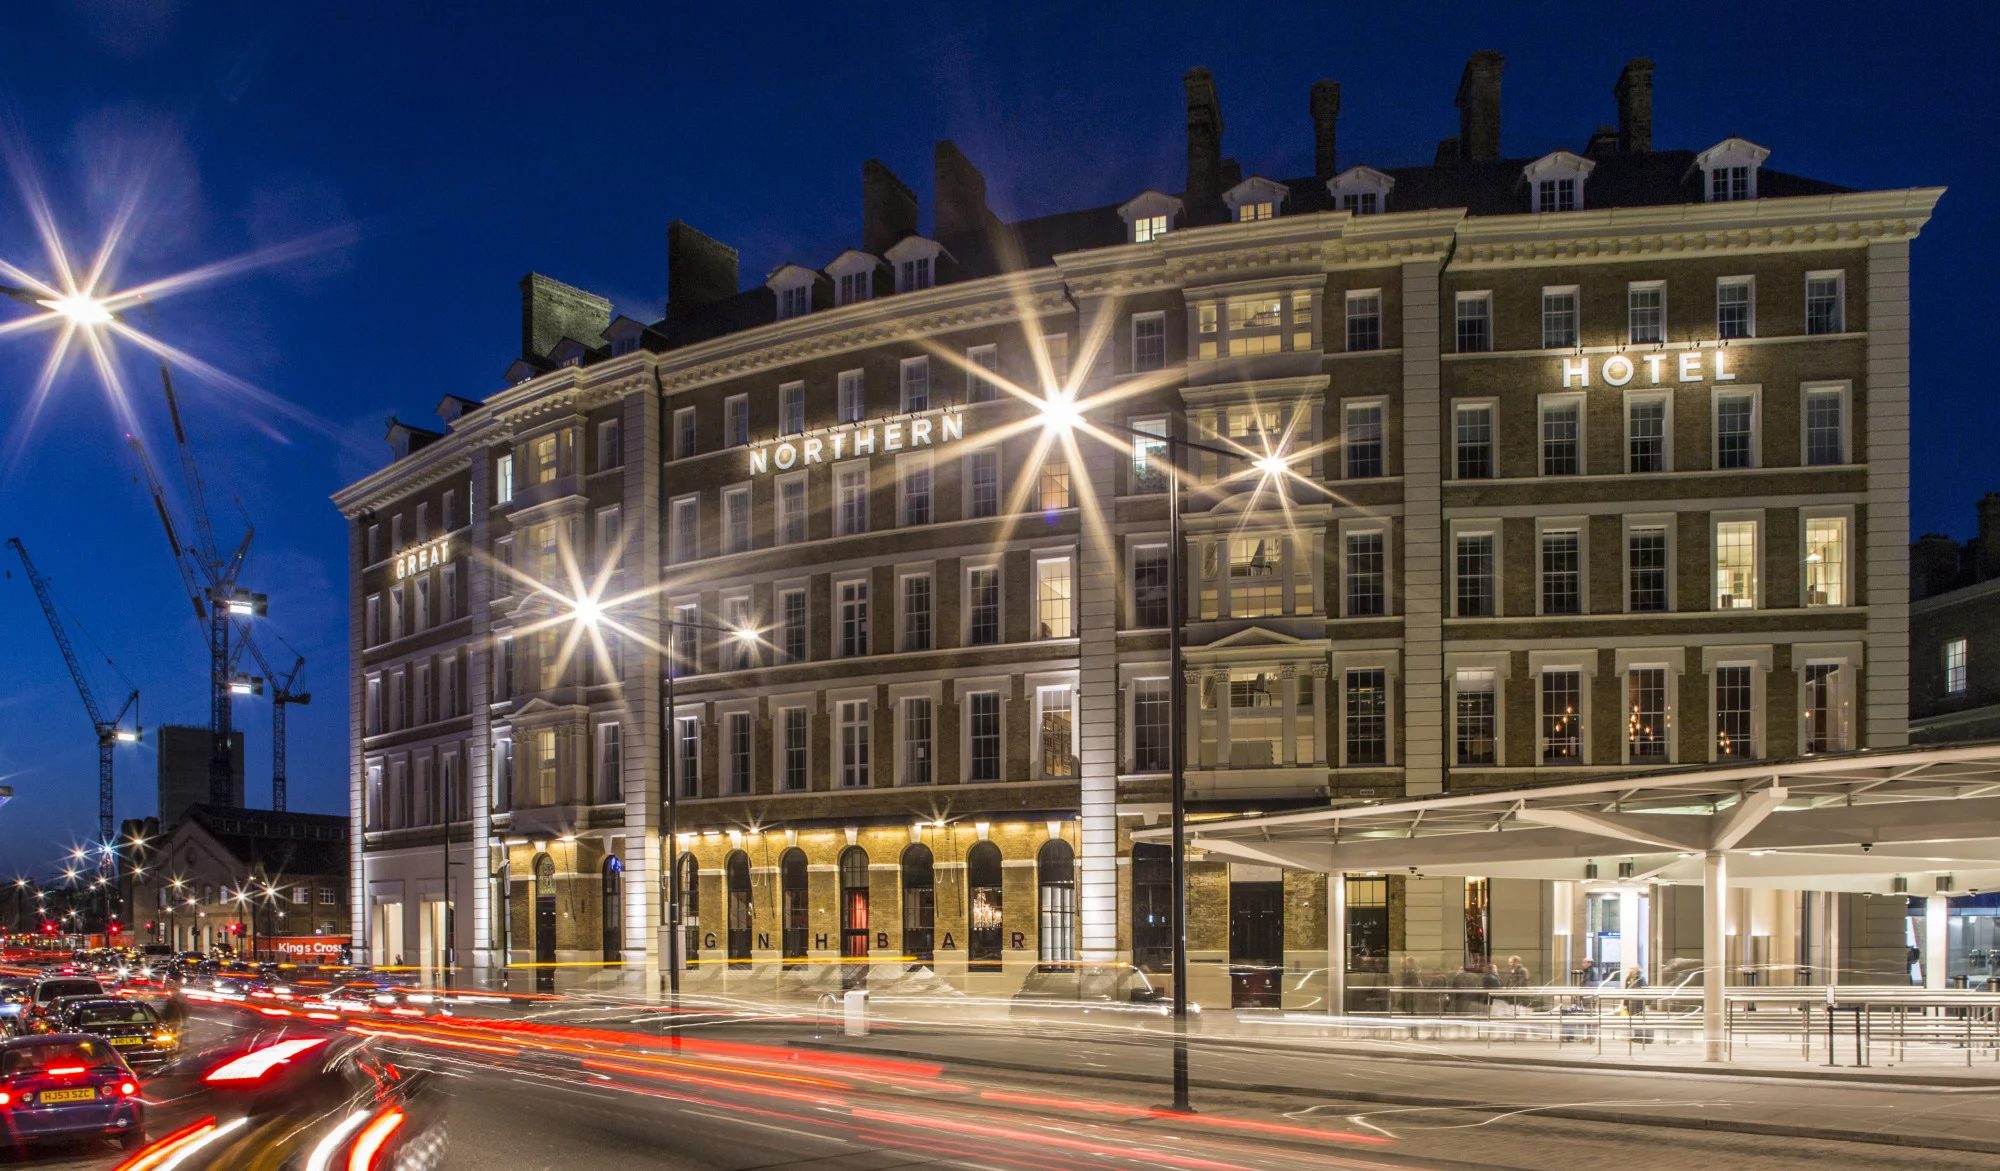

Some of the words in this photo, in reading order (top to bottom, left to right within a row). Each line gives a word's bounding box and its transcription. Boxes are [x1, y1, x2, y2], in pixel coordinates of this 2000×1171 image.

[396, 541, 449, 580] GREAT
[750, 413, 963, 476] NORTHERN
[1562, 351, 1736, 388] HOTEL
[876, 931, 1026, 949] BAR
[44, 1091, 70, 1101] HJ53
[71, 1090, 90, 1099] SZC
